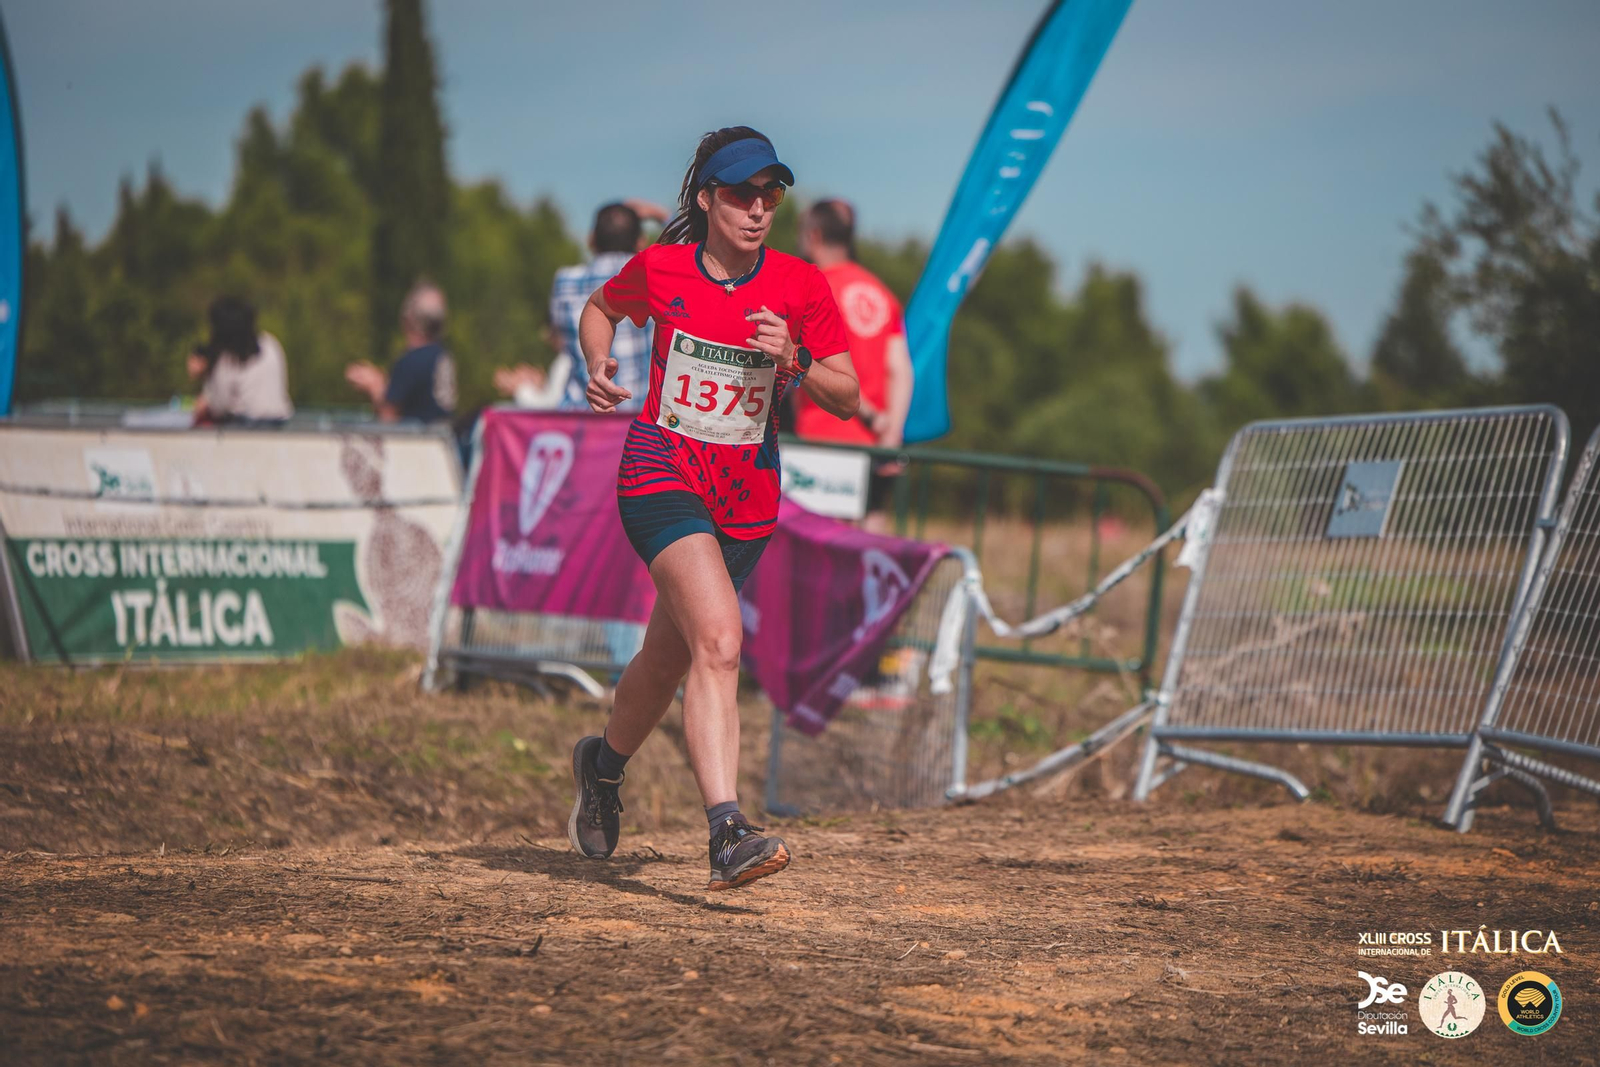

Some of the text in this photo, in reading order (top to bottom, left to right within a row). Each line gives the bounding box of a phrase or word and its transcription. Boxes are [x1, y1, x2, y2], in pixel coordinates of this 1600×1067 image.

[701, 346, 753, 365] ITÁLICA
[704, 370, 732, 378] ATLETISMO
[674, 374, 766, 417] 1375
[26, 541, 328, 579] CROSS INTERNACIONAL
[110, 577, 274, 647] ITÁLICA
